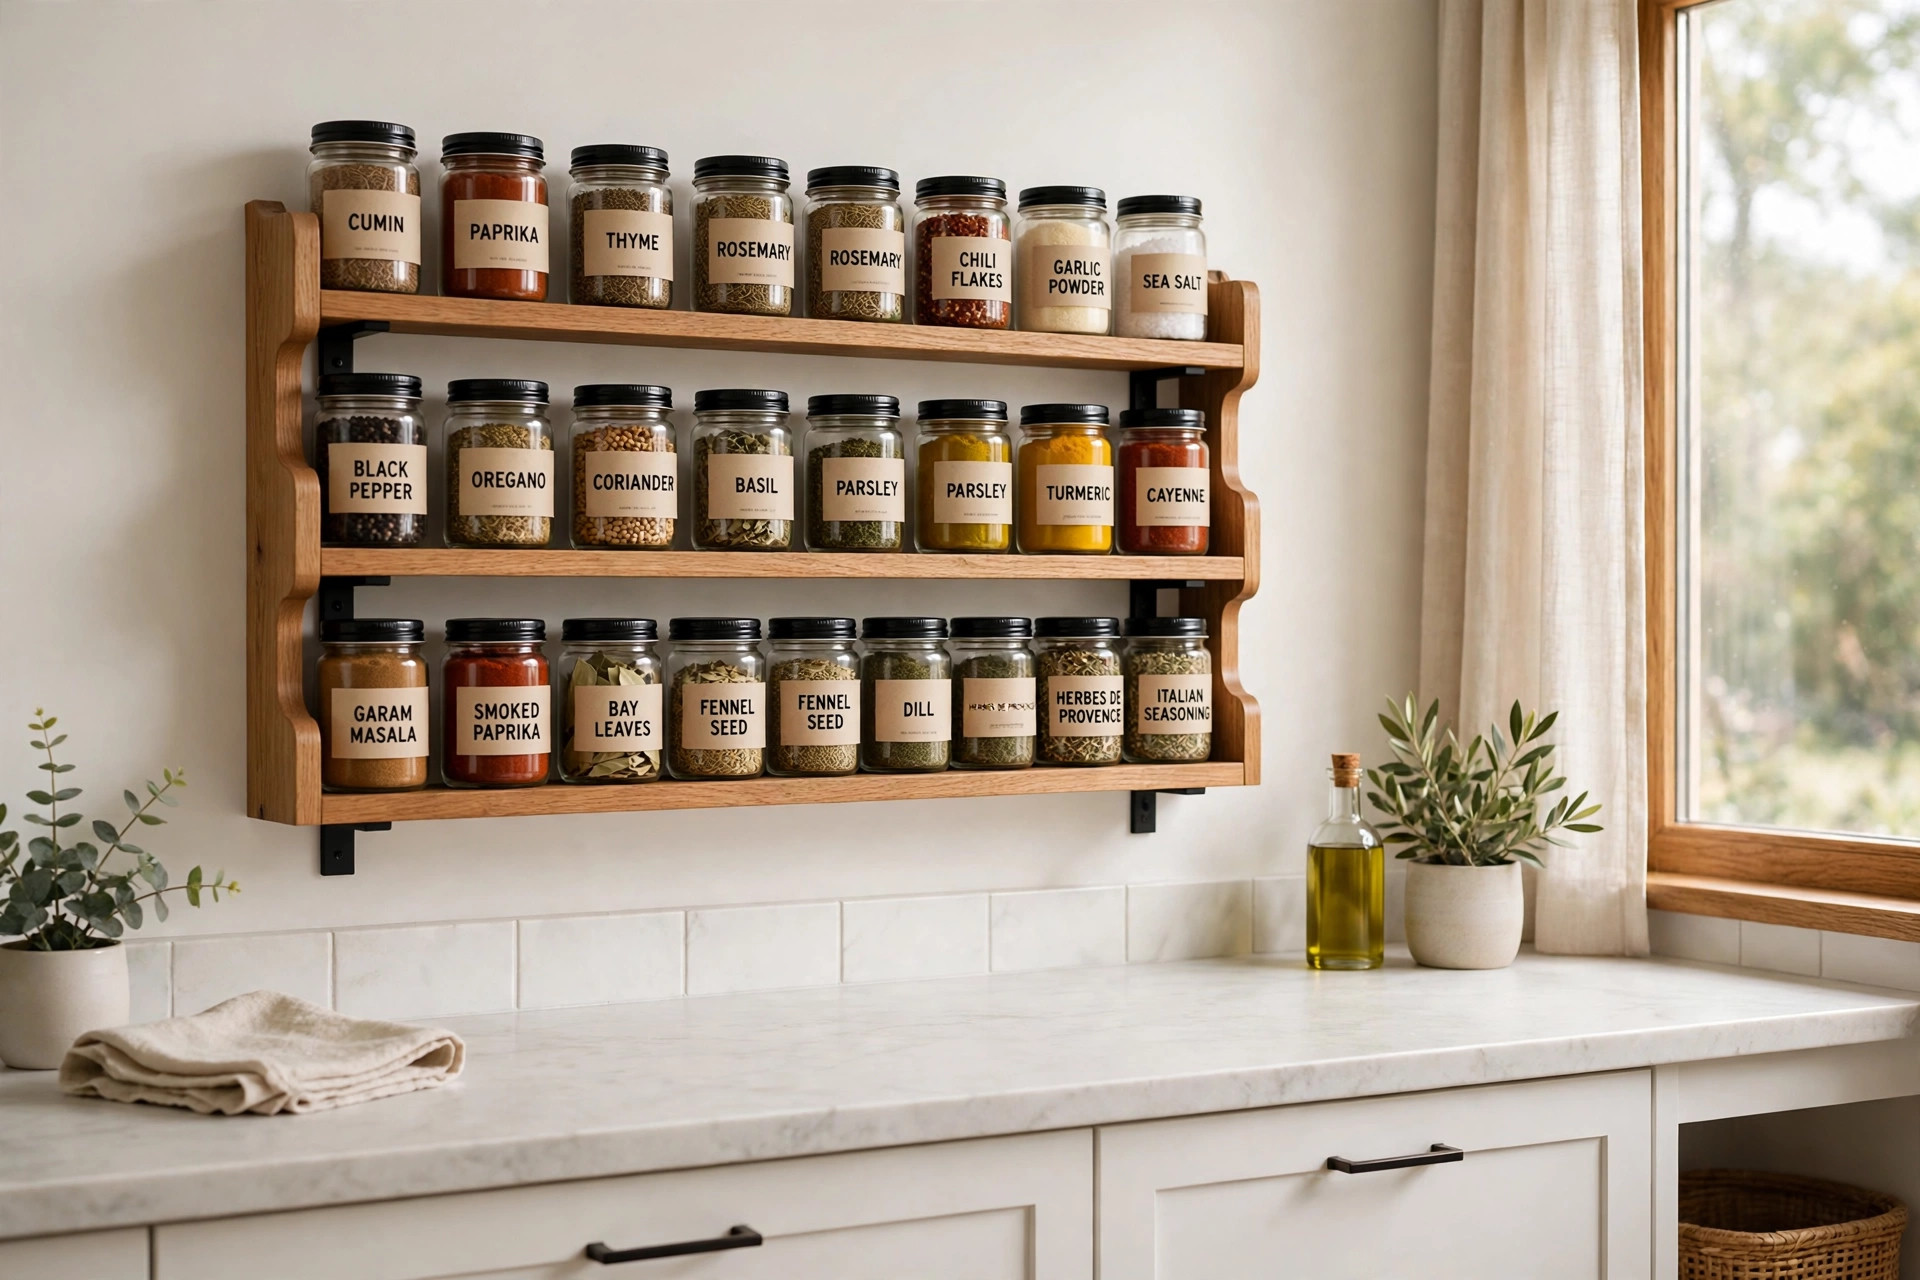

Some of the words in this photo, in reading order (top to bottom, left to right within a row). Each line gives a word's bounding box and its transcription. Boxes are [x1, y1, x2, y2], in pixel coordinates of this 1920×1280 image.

[347, 212, 404, 233] CUMIN
[470, 222, 539, 244] PAPRIKA
[605, 231, 659, 251] THYME
[716, 239, 792, 262] ROSEMARY
[830, 249, 902, 269] ROSEMARY
[959, 251, 996, 269] CHILI
[1053, 259, 1101, 277] GARLIC
[951, 270, 1003, 289] FLAKES
[1048, 278, 1104, 296] POWDER
[1143, 273, 1170, 289] SEA
[1174, 274, 1202, 291] SALT
[353, 459, 409, 478] BLACK
[471, 470, 546, 489] OREGANO
[592, 473, 674, 491] CORIANDER
[735, 476, 778, 494] BASIL
[836, 479, 898, 497] PARSLEY
[349, 481, 412, 500] PEPPER
[946, 482, 1007, 499] PARSLEY
[1045, 485, 1110, 501] TURMERIC
[1146, 487, 1205, 503] CAYENNE
[798, 694, 851, 711] FENNEL
[1056, 690, 1107, 706] HERBES
[1109, 689, 1123, 705] DE
[1157, 688, 1203, 704] ITALIAN
[353, 704, 412, 723] GARAM
[474, 702, 540, 721] SMOKED
[608, 700, 639, 717] BAY
[700, 698, 755, 716] FENNEL
[903, 701, 935, 718] DILL
[1058, 707, 1122, 724] PROVENCE
[1143, 704, 1211, 722] SEASONING
[594, 720, 651, 738] LEAVES
[710, 719, 748, 736] SEED
[807, 713, 844, 730] SEED
[350, 726, 417, 744] MASALA
[473, 723, 541, 741] PAPRIKA
